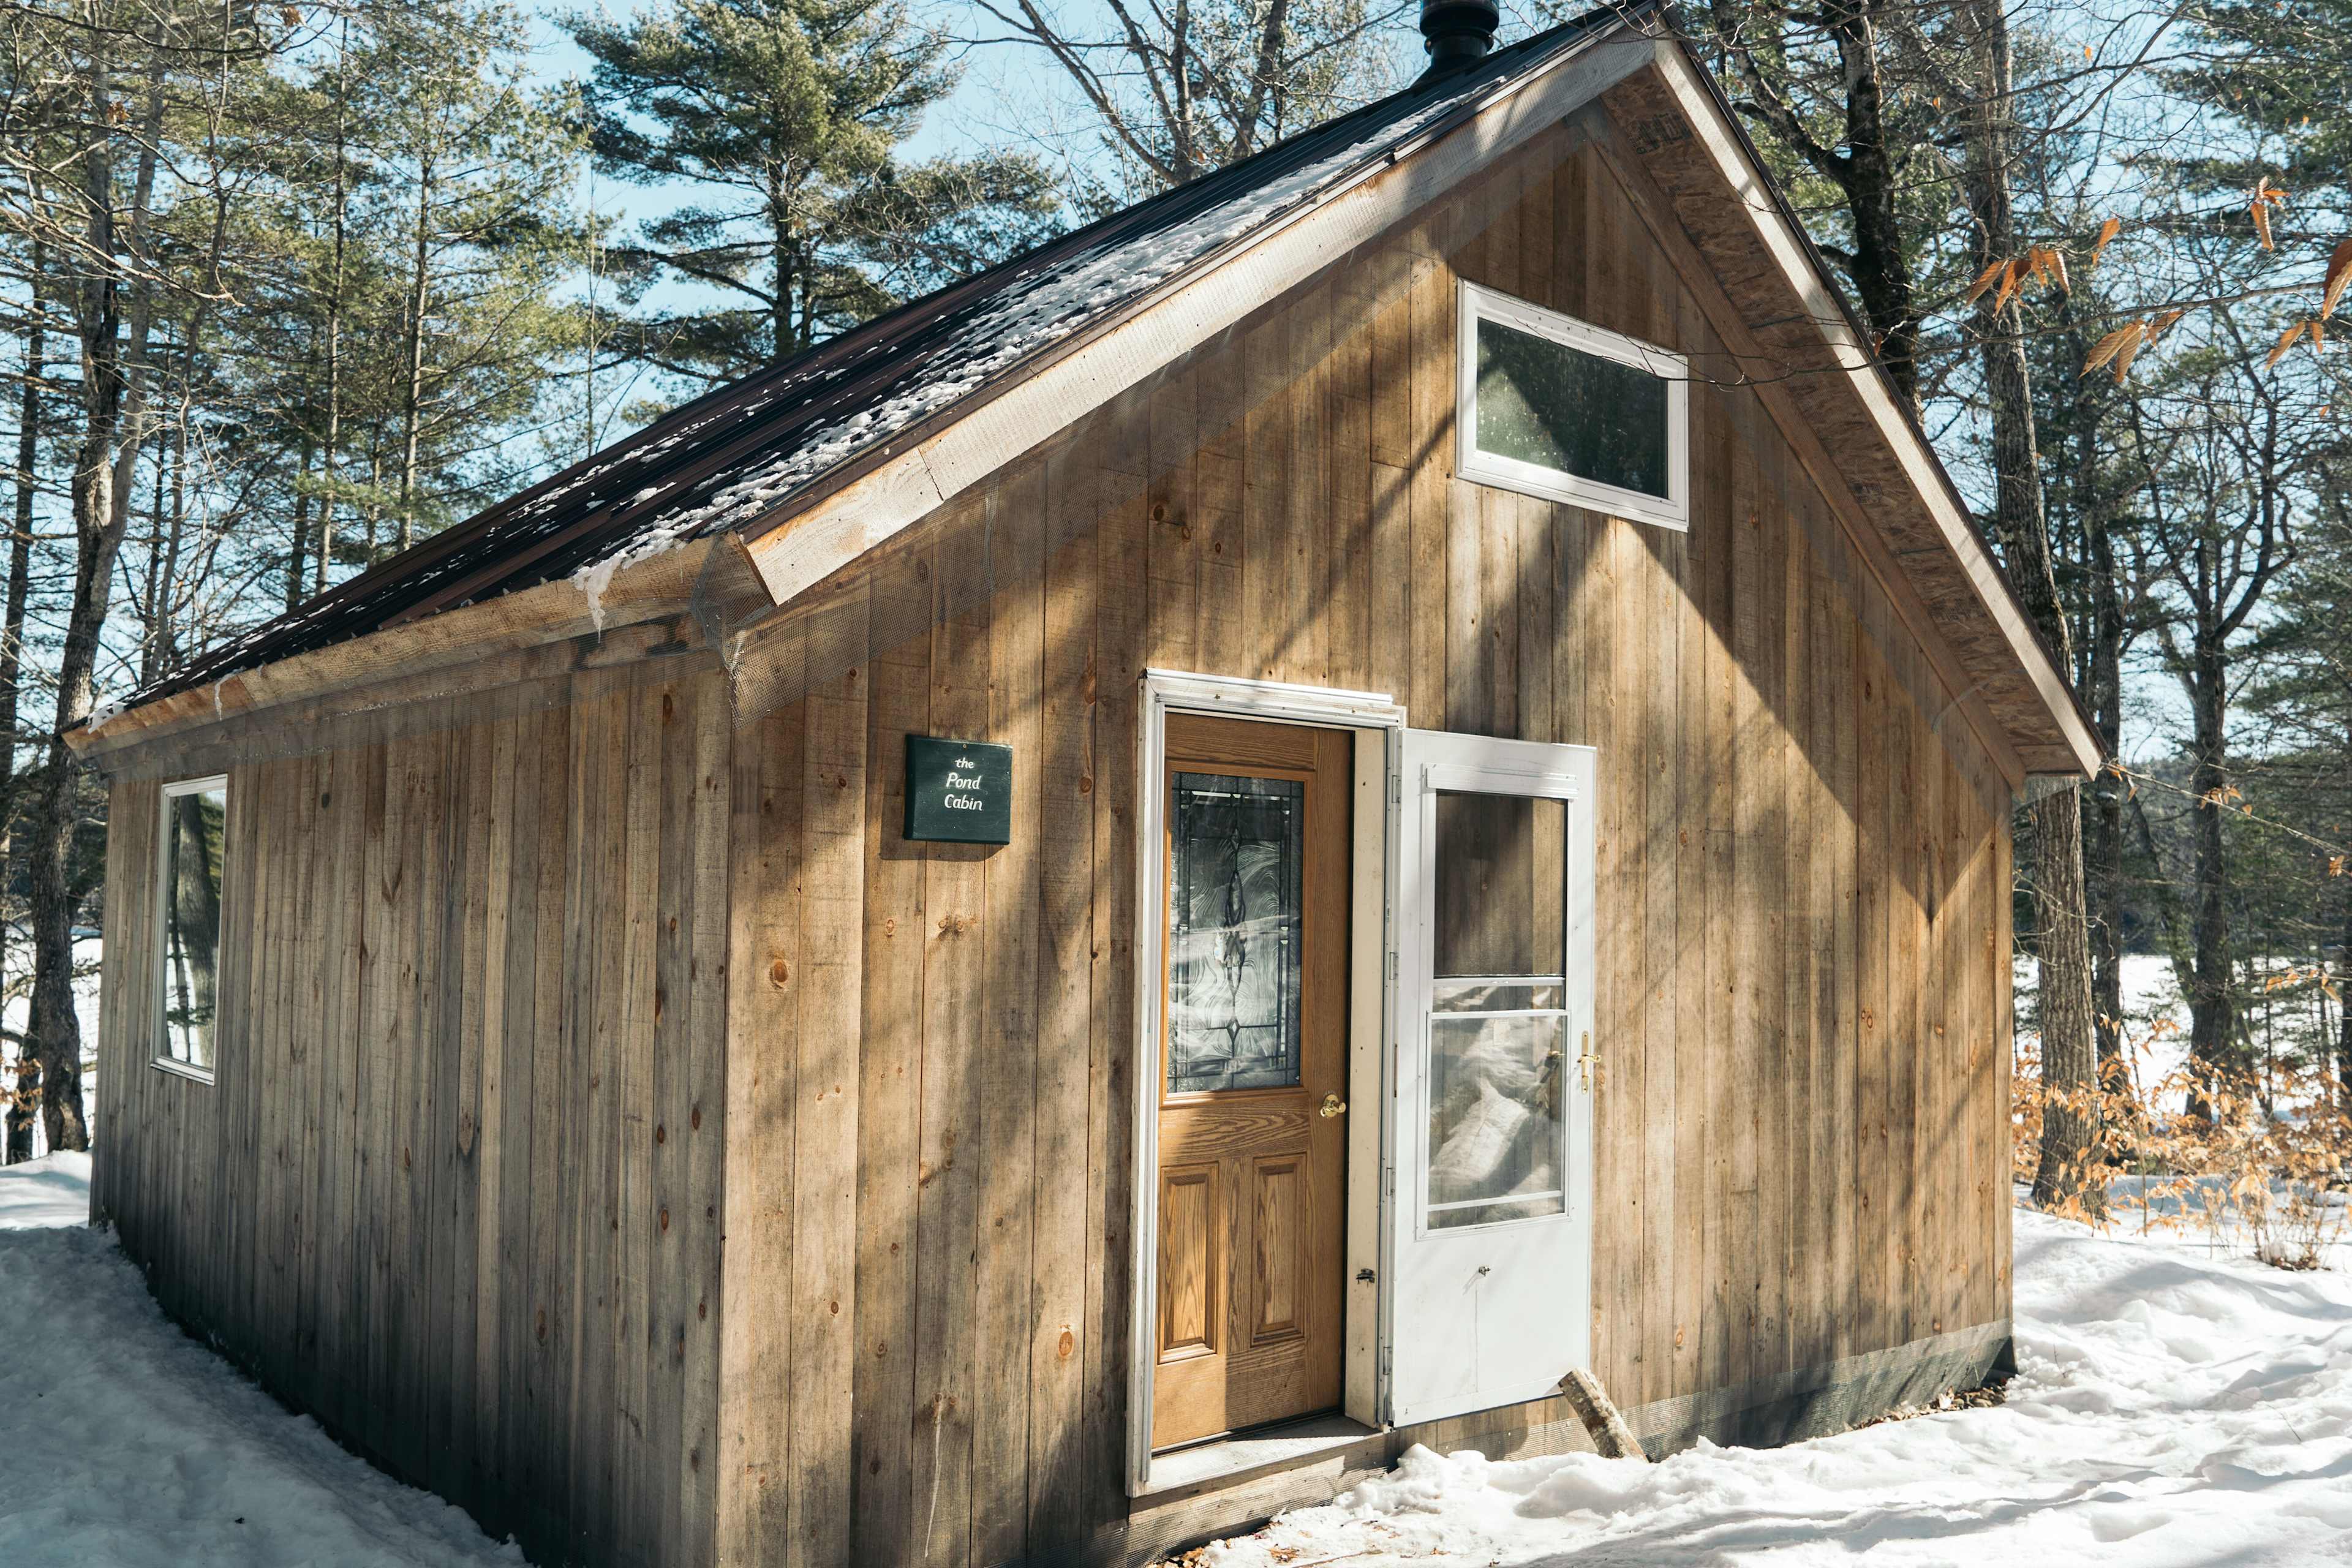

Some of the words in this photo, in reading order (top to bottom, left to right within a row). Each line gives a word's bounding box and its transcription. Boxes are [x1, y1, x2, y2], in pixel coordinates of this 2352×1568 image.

[955, 757, 975, 769] the
[945, 772, 982, 790] Pond
[944, 793, 983, 812] Cabin
